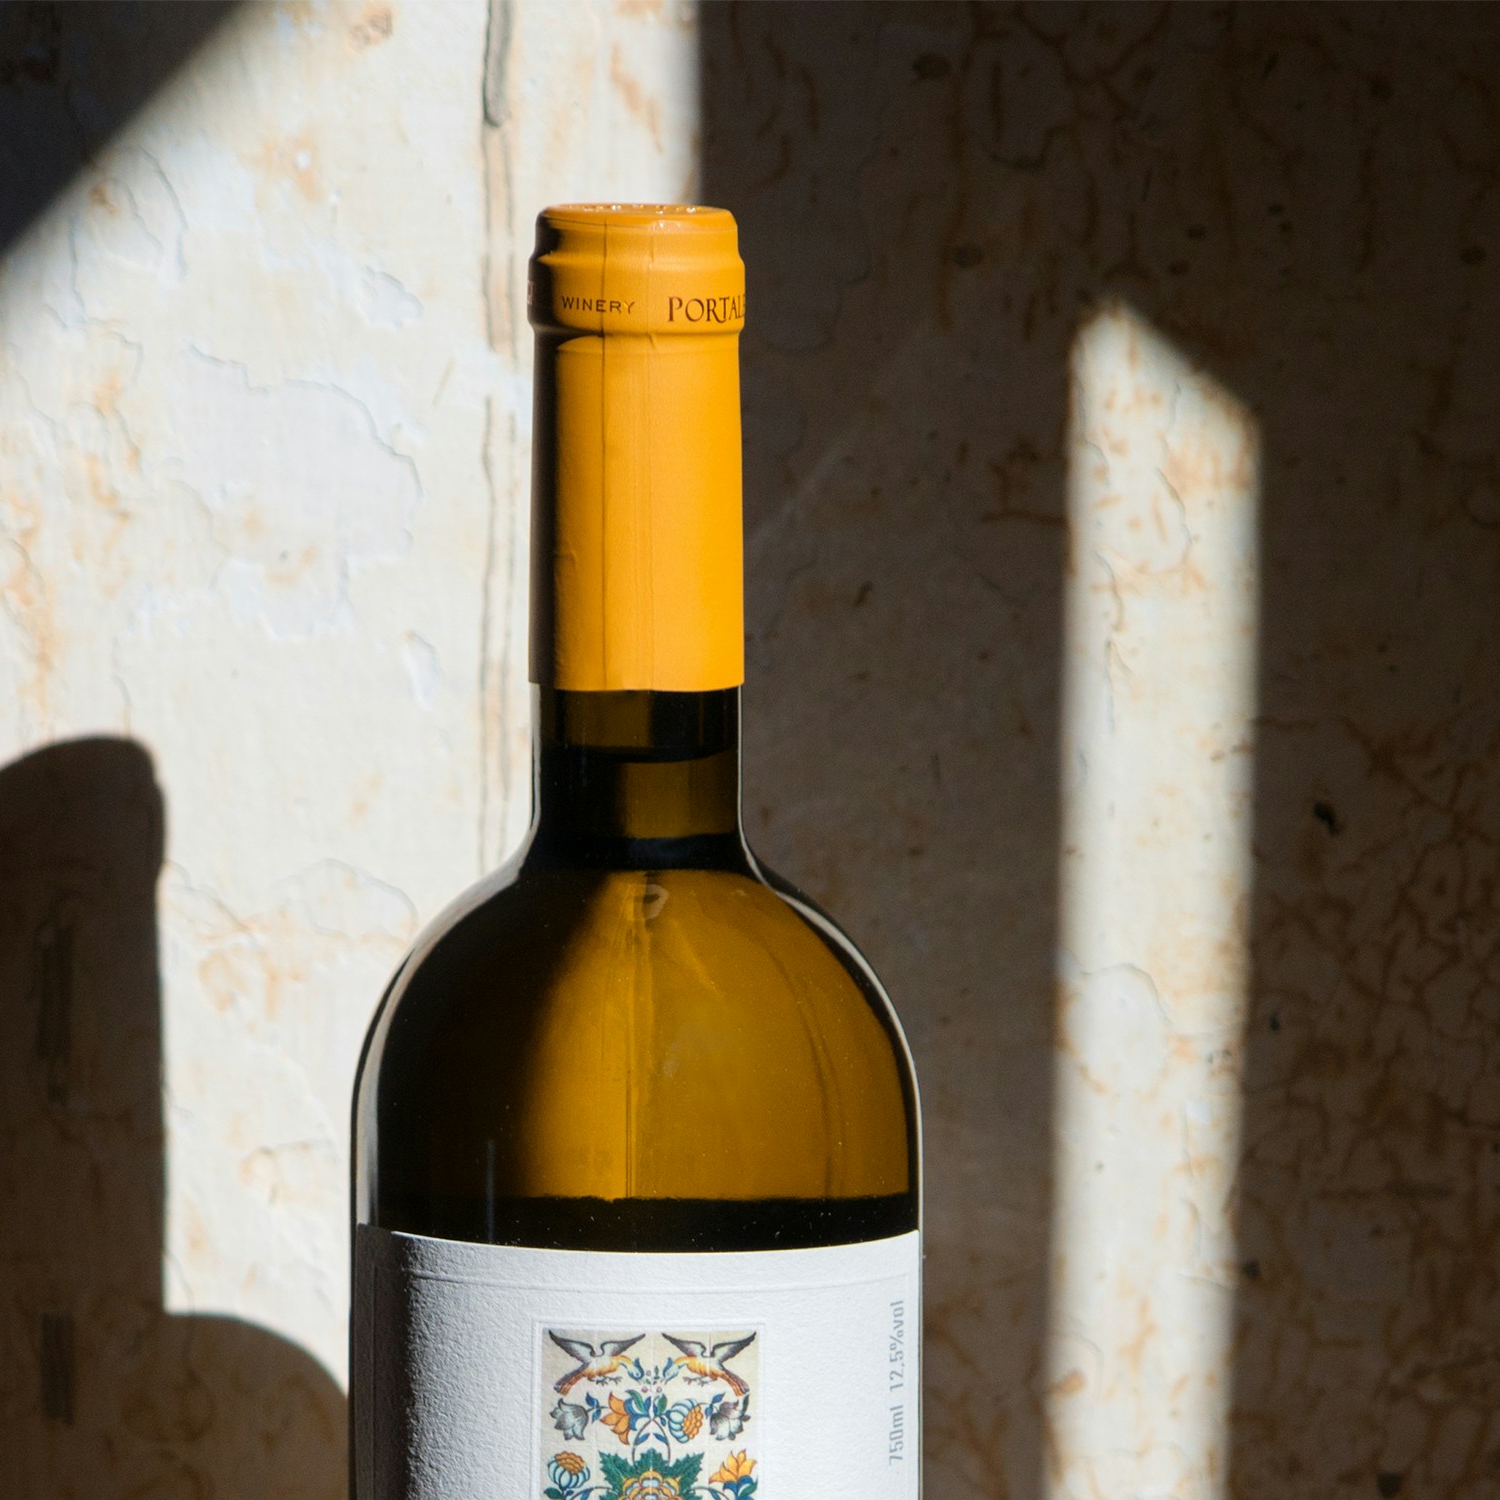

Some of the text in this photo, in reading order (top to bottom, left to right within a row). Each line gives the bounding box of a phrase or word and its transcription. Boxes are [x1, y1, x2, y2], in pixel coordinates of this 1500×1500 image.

[561, 293, 746, 324] WINERY PORTAL
[889, 1404, 904, 1467] 750ml
